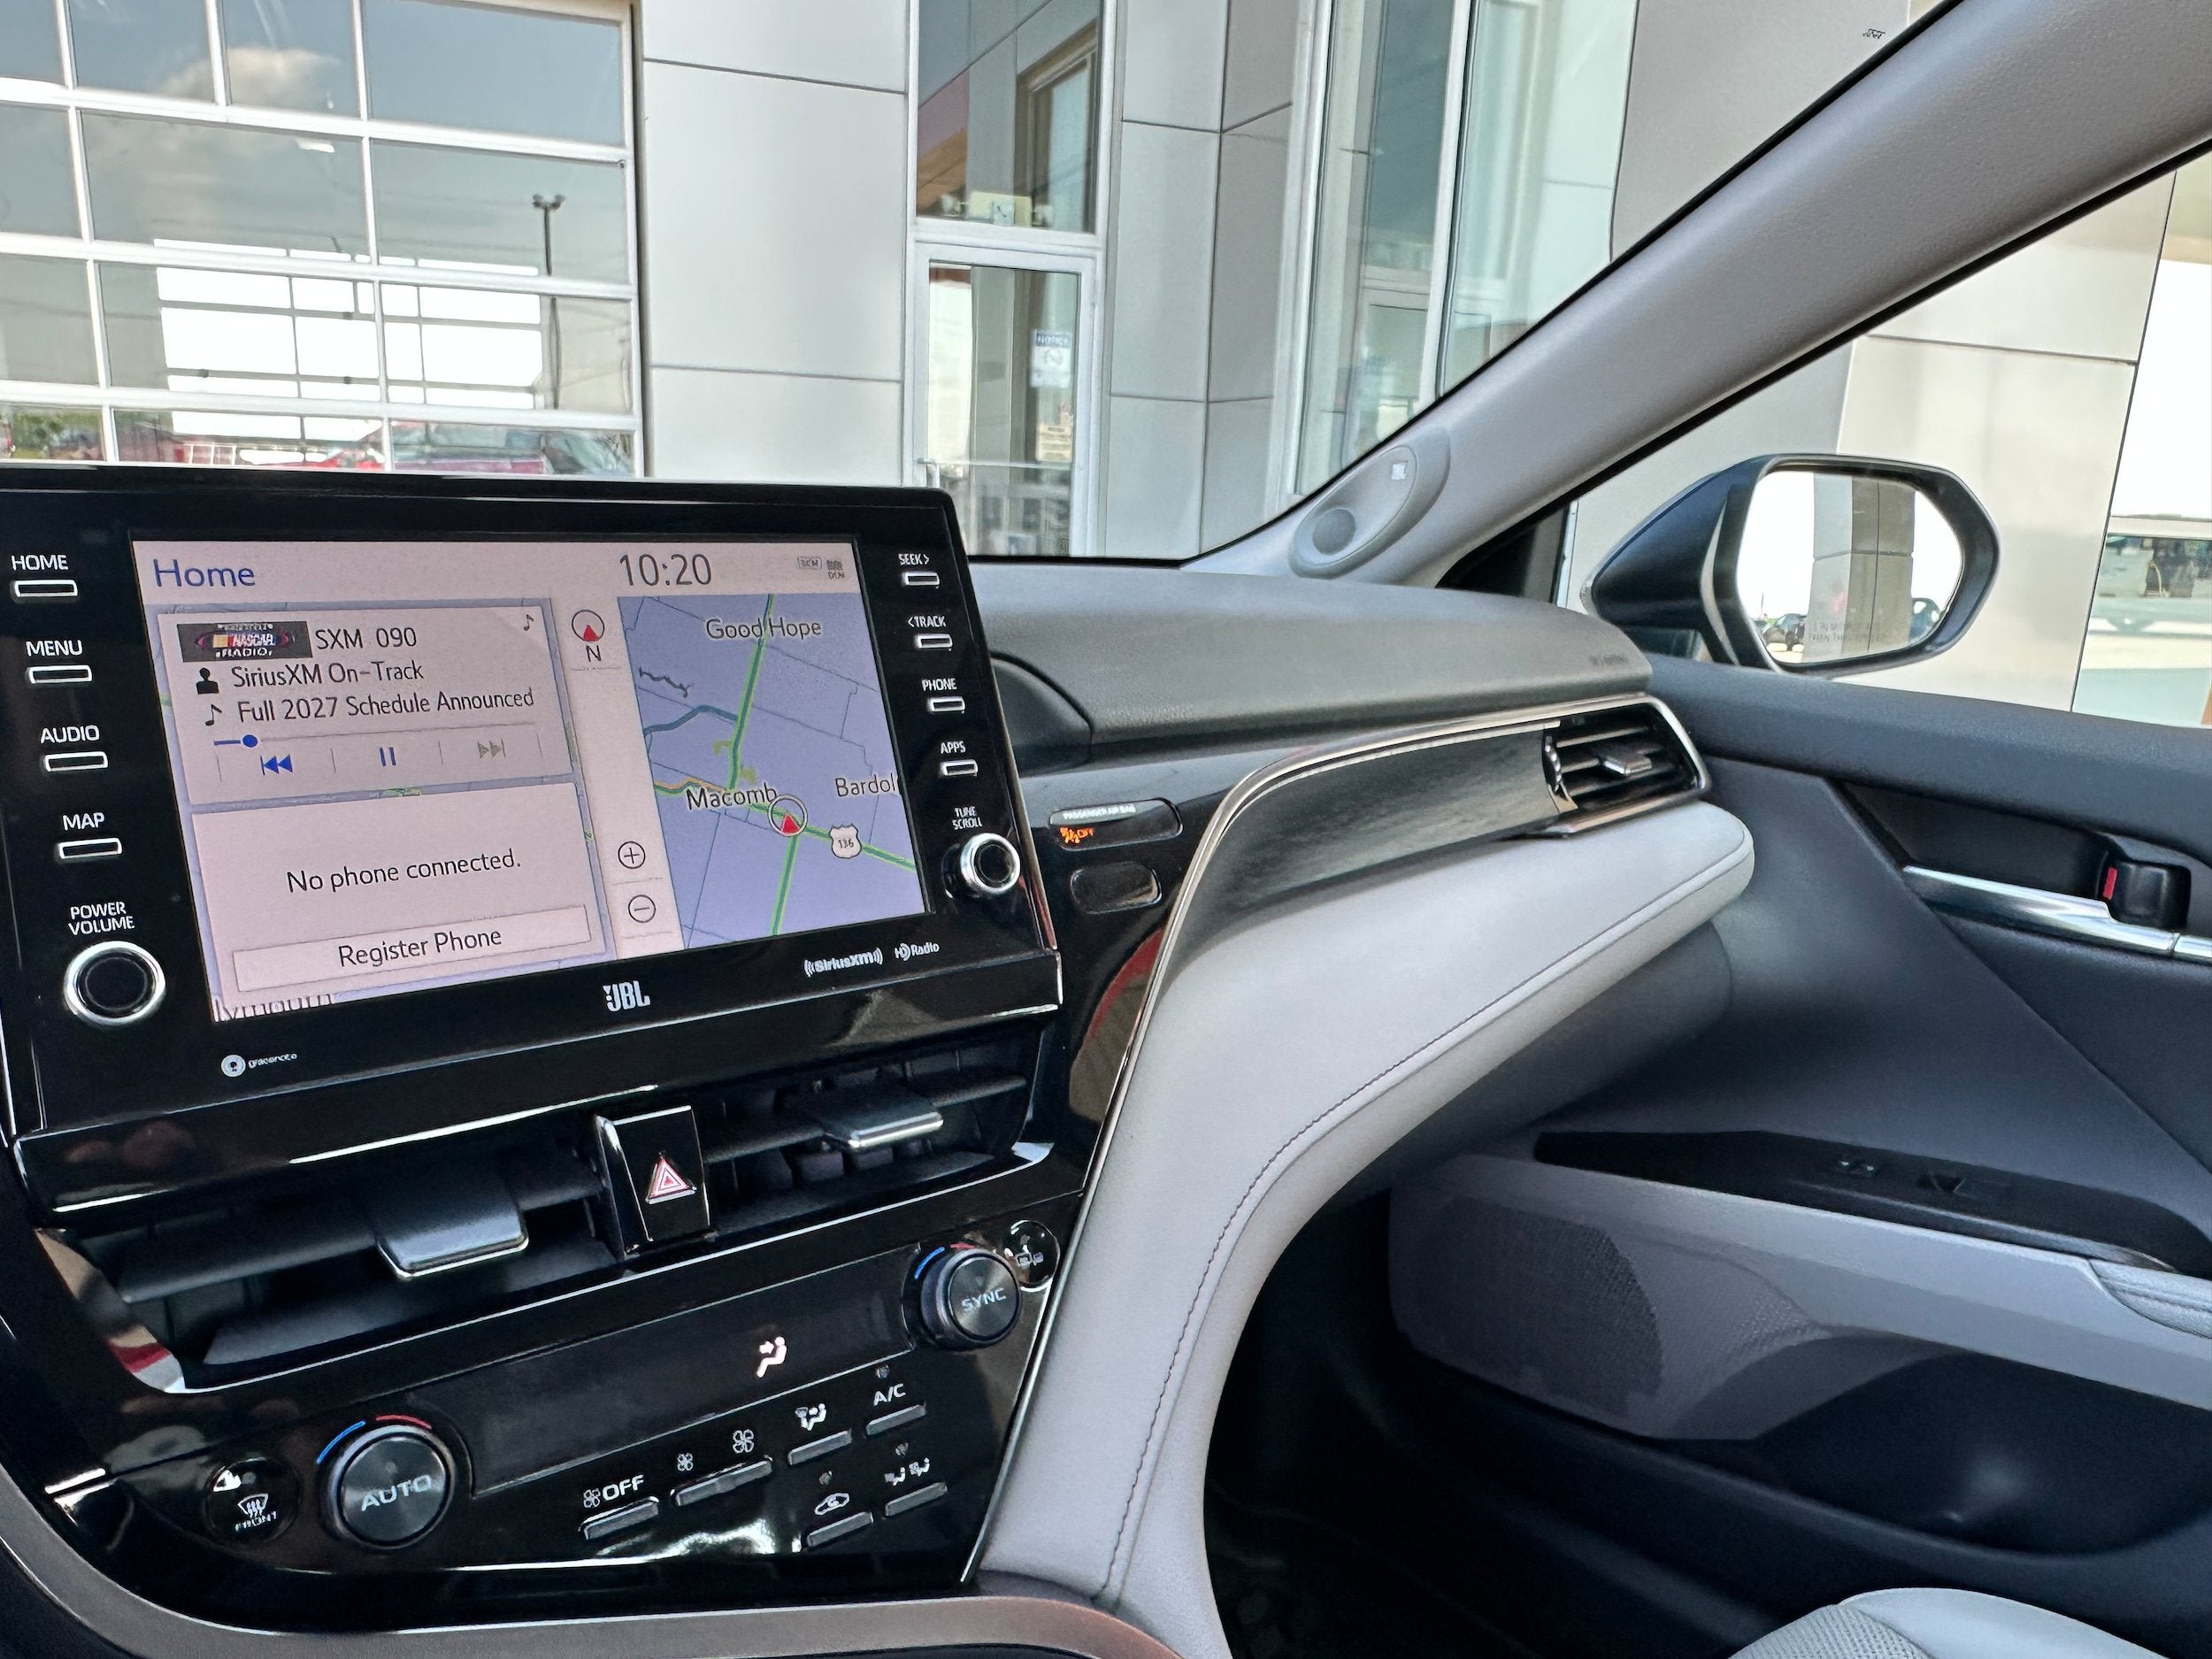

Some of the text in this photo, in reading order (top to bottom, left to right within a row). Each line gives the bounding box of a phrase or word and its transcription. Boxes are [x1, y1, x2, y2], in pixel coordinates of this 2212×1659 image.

[11, 554, 69, 571] HOME
[152, 558, 256, 588] Home
[619, 553, 712, 587] 10:20
[315, 626, 417, 650] SXM 090
[706, 617, 822, 640] Good Hope
[26, 639, 83, 657] MENU
[586, 644, 602, 663] N
[231, 660, 425, 687] SiriusXM On-Track
[921, 677, 957, 692] PHONE
[238, 686, 534, 722] Full 2027 Schedule Announced
[40, 725, 100, 744] AUDIO
[940, 741, 966, 755] APPS
[686, 782, 778, 810] Macomb
[62, 811, 105, 831] MAP
[951, 817, 983, 830] SCROLL
[839, 838, 856, 849] 136
[287, 848, 522, 894] No phone connected.
[70, 901, 127, 920] POWER
[68, 916, 135, 936] VOLUME
[338, 926, 503, 967] Register Phone
[910, 942, 941, 956] Radio
[603, 980, 651, 1012] JBL
[960, 1287, 1007, 1311] SYNC
[873, 1383, 907, 1406] A/C
[360, 1473, 432, 1512] AUTO
[602, 1474, 645, 1502] OFF
